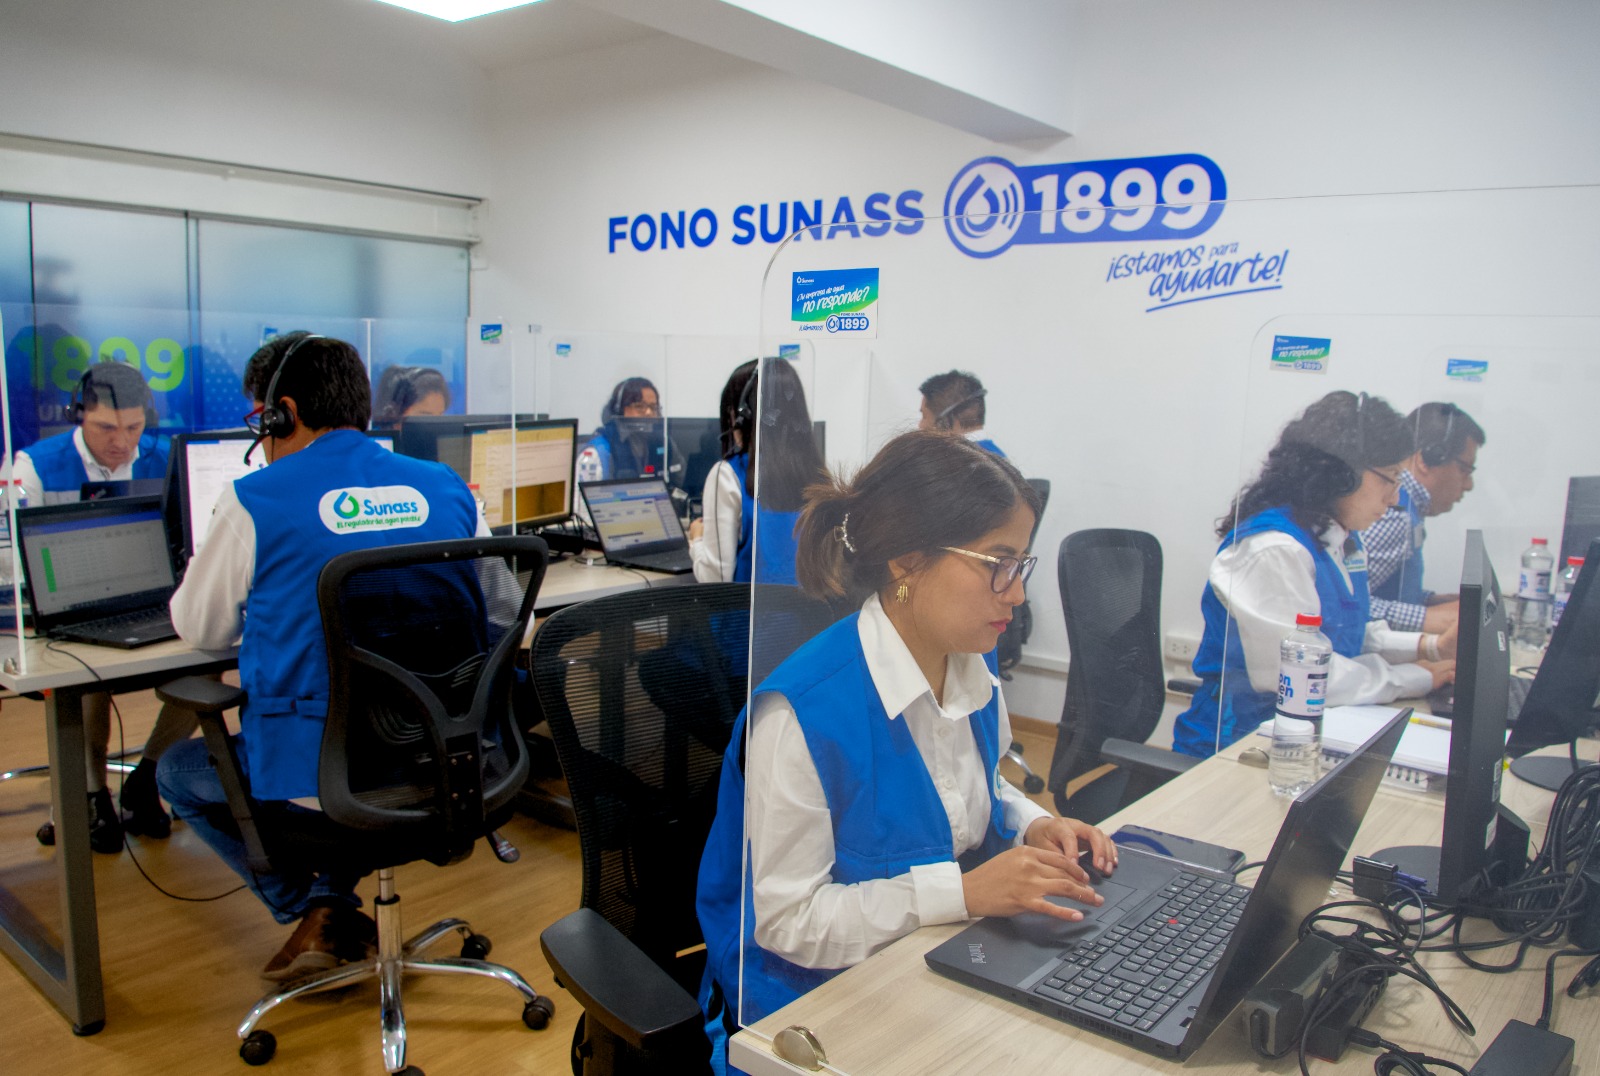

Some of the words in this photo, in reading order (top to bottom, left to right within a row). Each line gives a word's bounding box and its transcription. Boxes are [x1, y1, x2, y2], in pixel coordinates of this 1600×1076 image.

[1032, 163, 1212, 234] 1899
[609, 208, 718, 253] FONO
[732, 190, 924, 245] SUNASS
[1106, 245, 1206, 282] ¡Estamos
[1209, 242, 1239, 261] para
[1149, 250, 1289, 302] ayudarte!
[802, 299, 816, 314] no
[816, 286, 870, 310] responde?
[840, 318, 868, 330] 1899
[363, 499, 418, 516] Sunass
